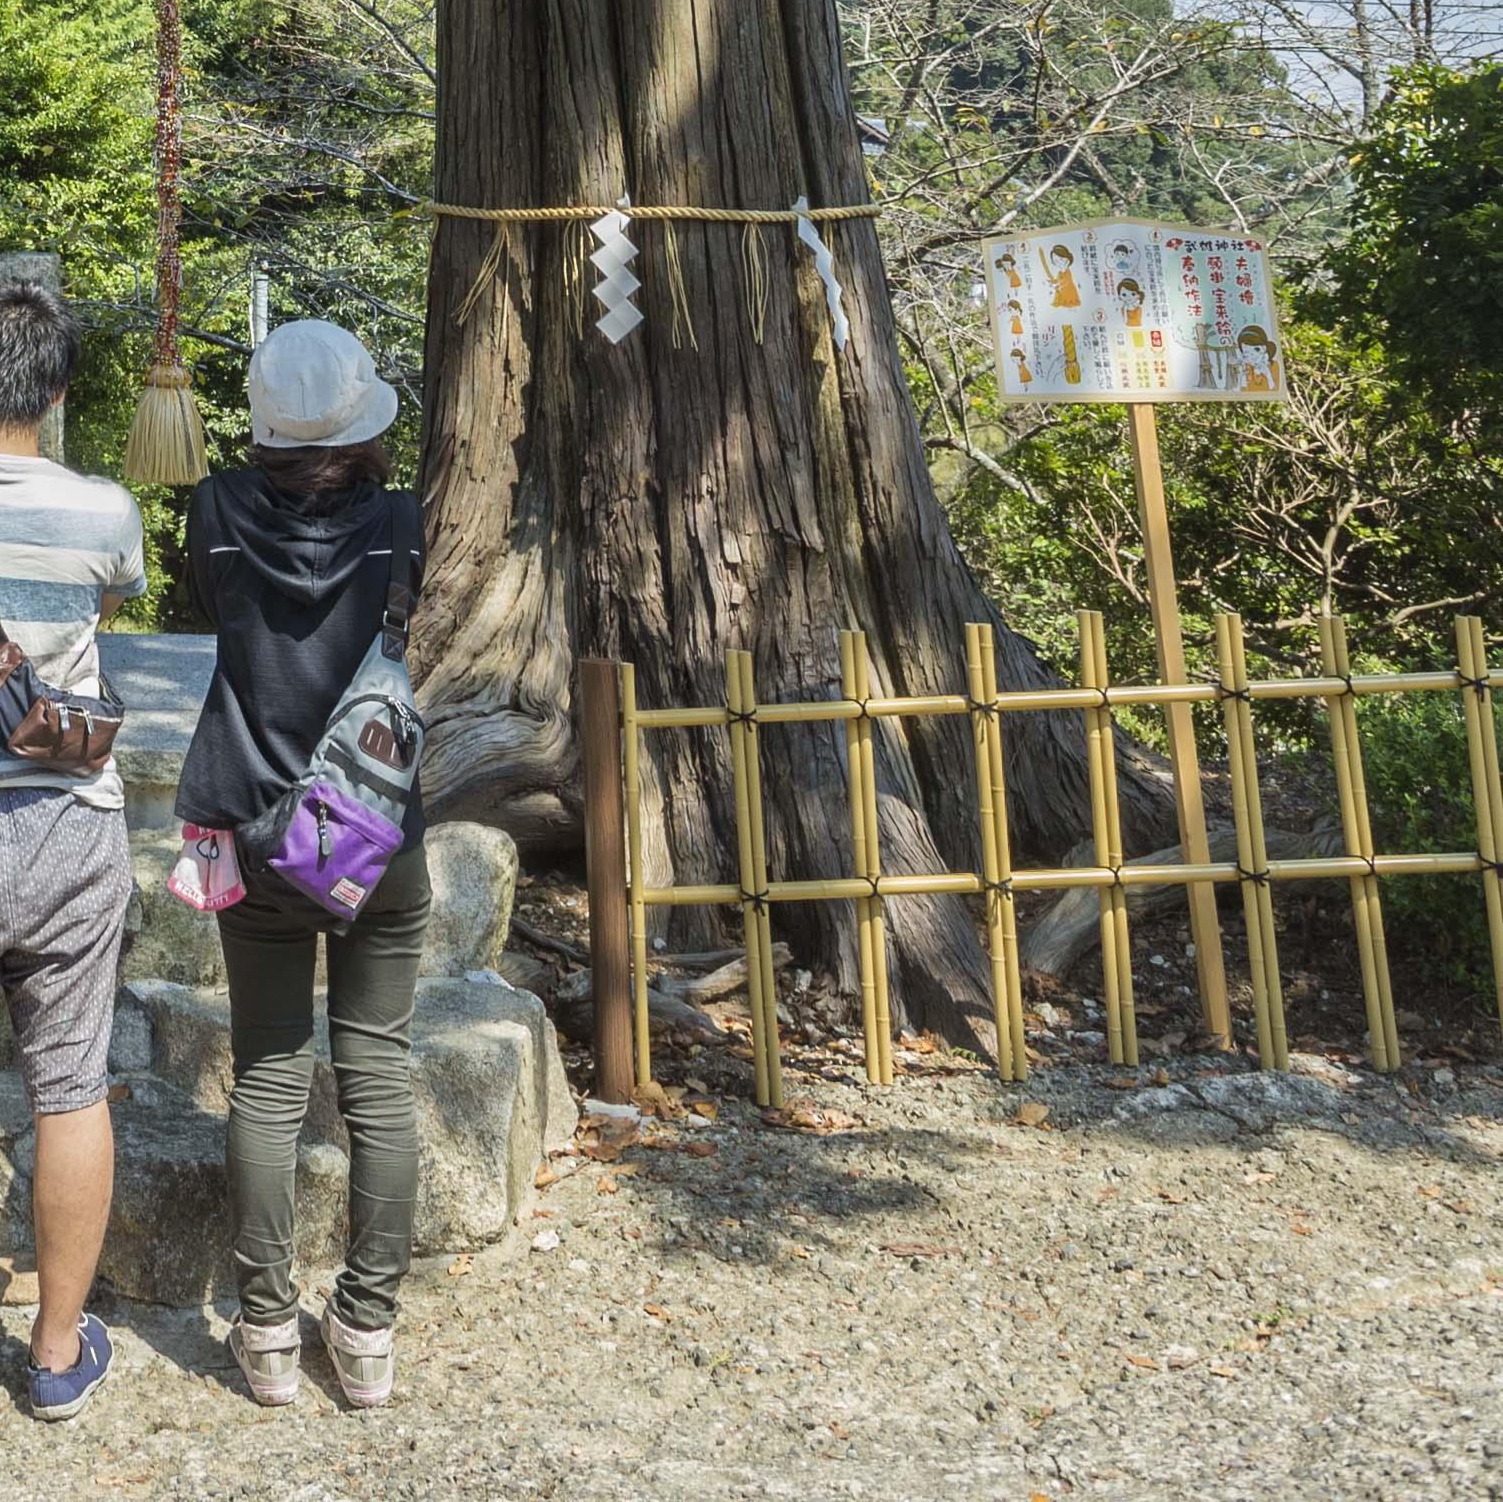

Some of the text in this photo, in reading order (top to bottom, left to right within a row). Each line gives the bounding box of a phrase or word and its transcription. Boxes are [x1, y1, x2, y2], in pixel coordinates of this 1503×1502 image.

[1185, 239, 1244, 253] 武雄神社
[1181, 255, 1202, 317] 奉納作法
